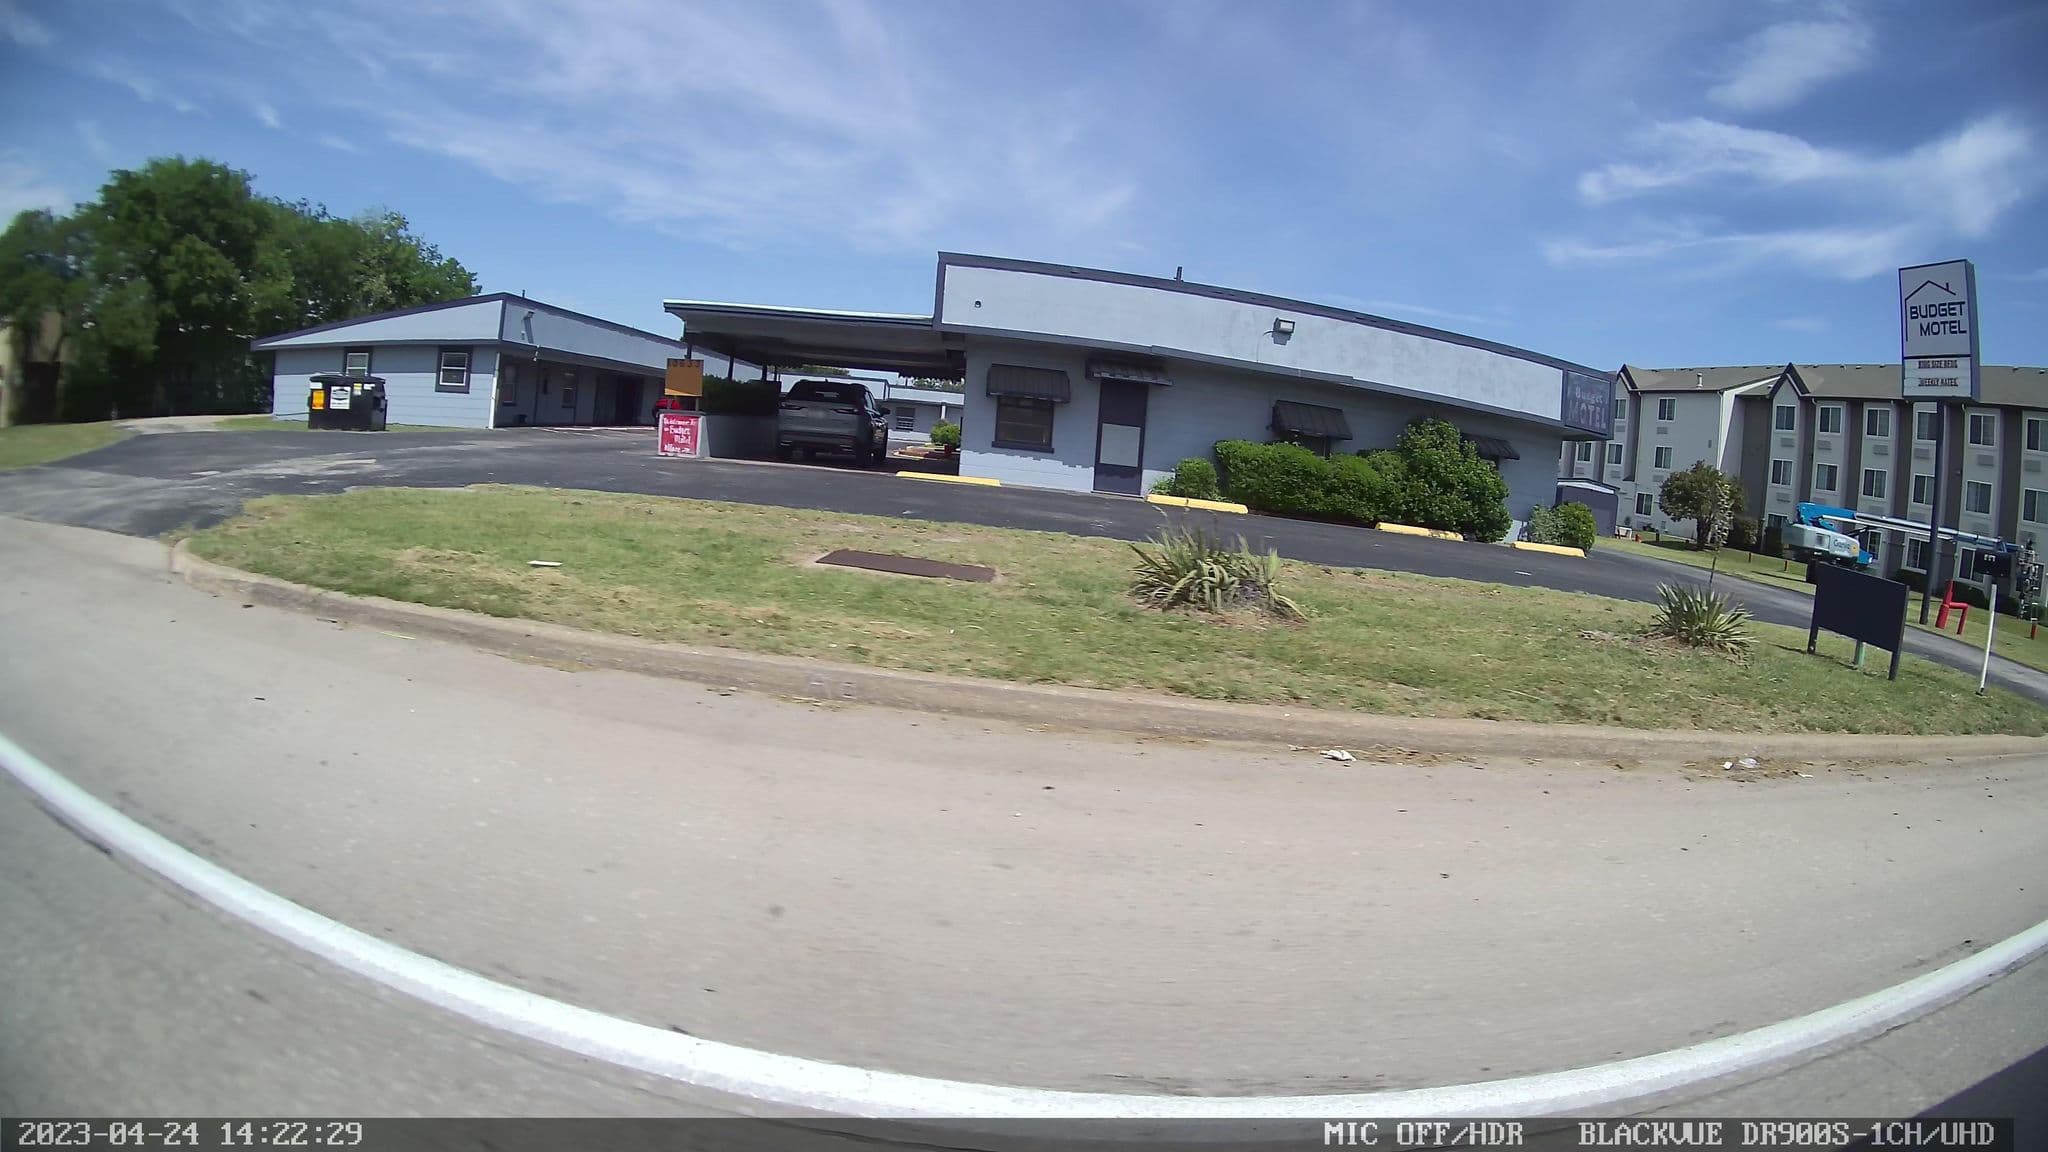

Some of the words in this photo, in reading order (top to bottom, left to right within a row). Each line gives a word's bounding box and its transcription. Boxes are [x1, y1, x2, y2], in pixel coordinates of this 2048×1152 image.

[1910, 301, 1965, 319] BUDGET
[1919, 320, 1967, 336] MOTEL
[1568, 400, 1607, 429] MOTEL
